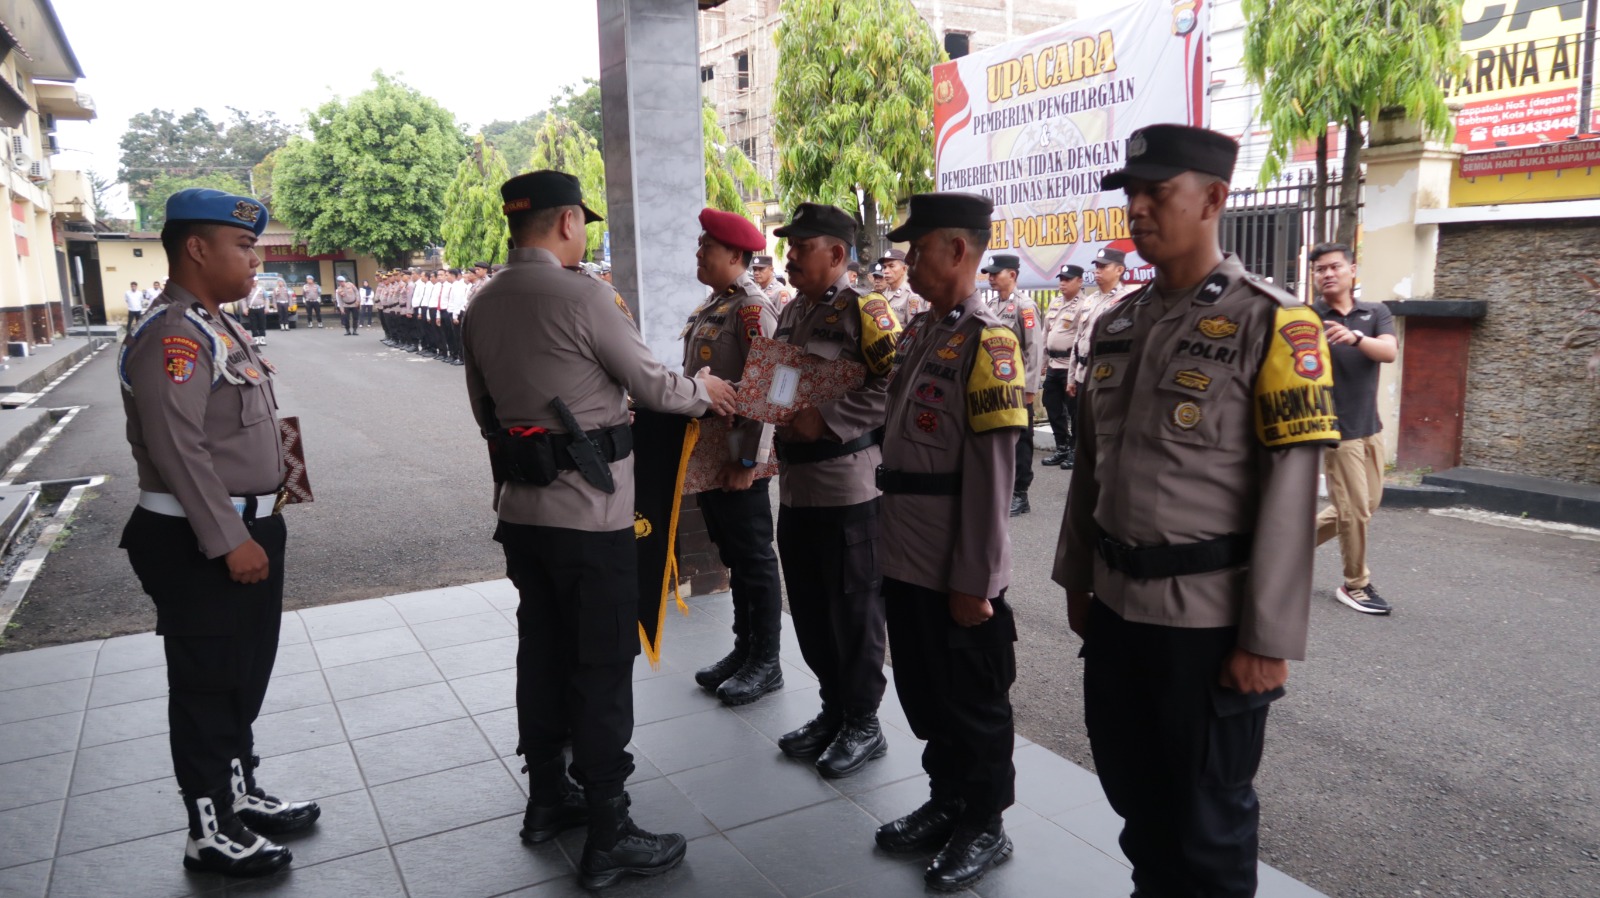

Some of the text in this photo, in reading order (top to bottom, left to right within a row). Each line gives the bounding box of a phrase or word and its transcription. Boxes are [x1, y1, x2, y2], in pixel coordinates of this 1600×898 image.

[986, 29, 1117, 103] UPACARA
[973, 77, 1136, 136] PEMBERIAN PENGHARGAAN
[1502, 110, 1525, 121] Kota
[1527, 104, 1572, 118] Parepare
[1039, 123, 1050, 147] &
[1525, 145, 1559, 156] MALAM
[1562, 142, 1596, 153] SEMUA
[941, 157, 1024, 192] PEMBERHENTIAN
[1027, 149, 1063, 176] TIDAK
[1067, 140, 1120, 170] DENGAN
[1462, 161, 1493, 172] SEMUA
[1495, 159, 1517, 169] HARI
[1519, 156, 1545, 167] BUKA
[1548, 153, 1584, 164] SAMPAI
[1010, 180, 1043, 204] DINAS
[1013, 210, 1079, 249] POLRES
[271, 246, 288, 256] SIE
[167, 348, 196, 359] PROPAM
[173, 337, 198, 350] PROPAM
[1176, 339, 1238, 365] POLRI
